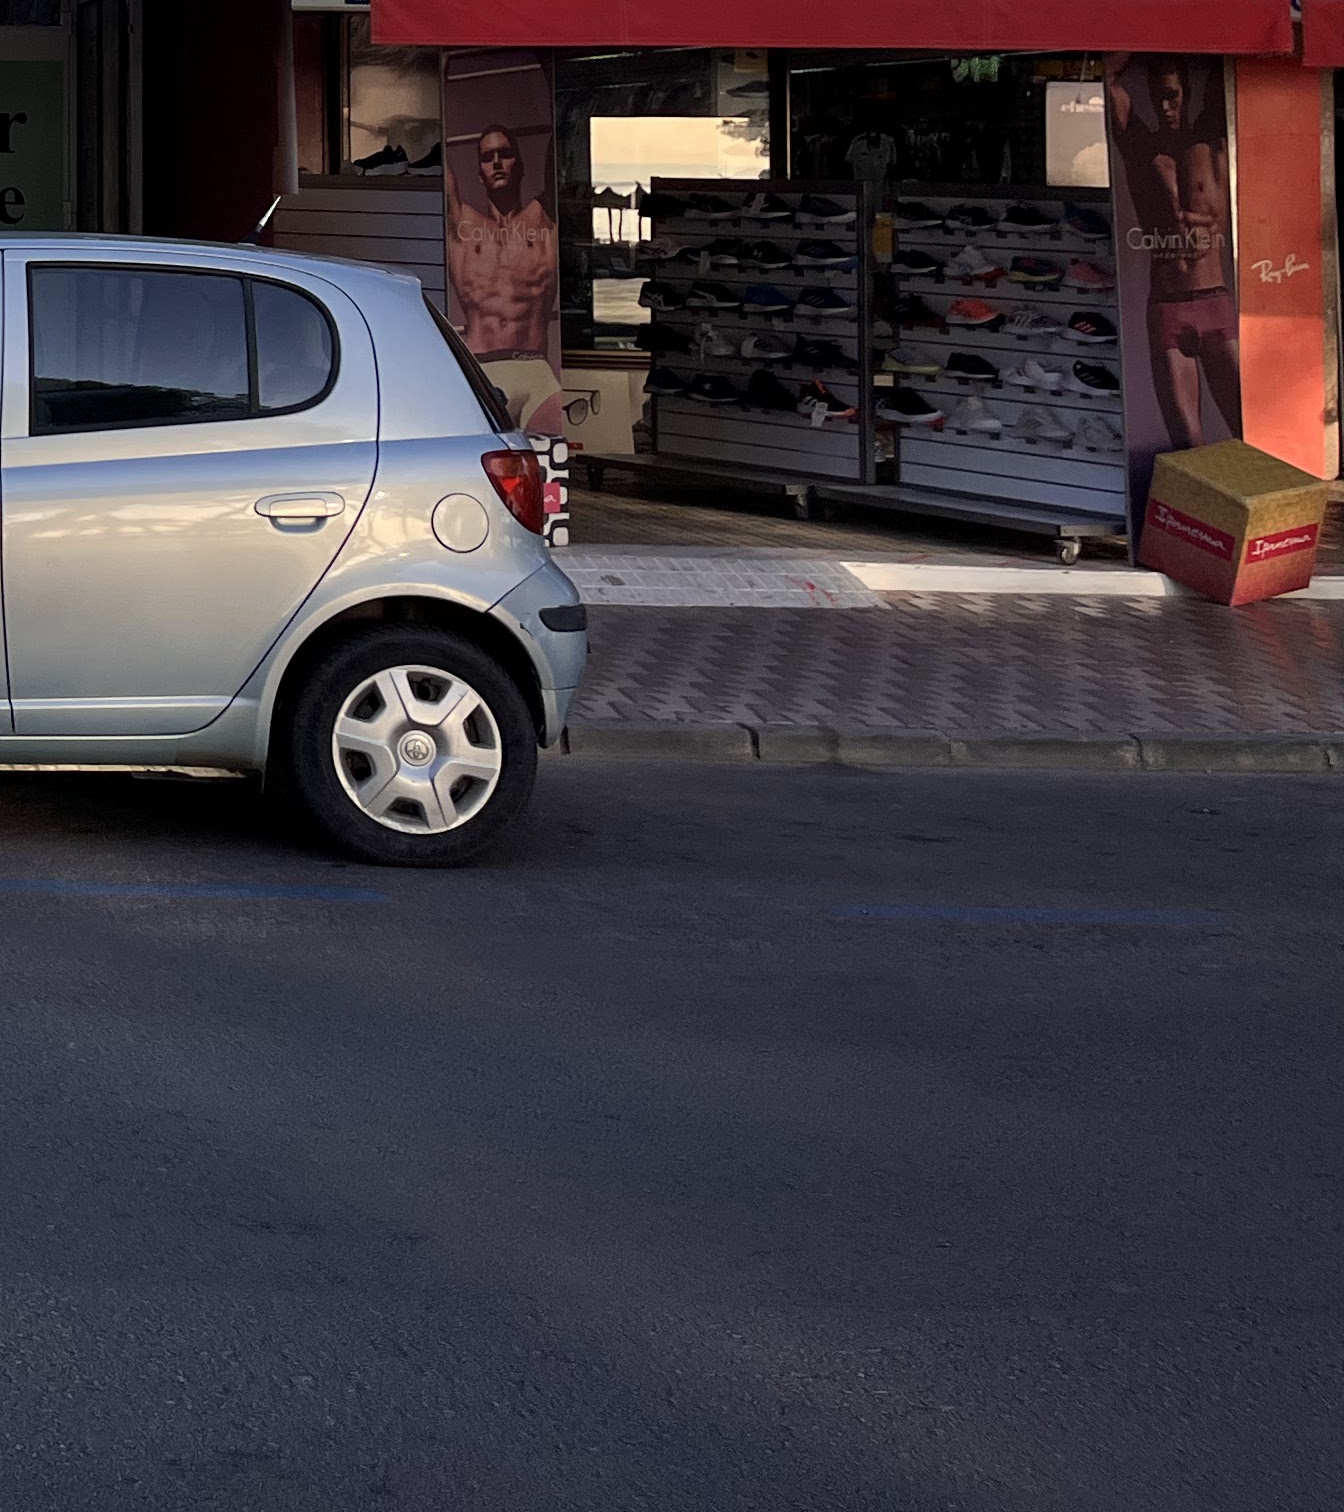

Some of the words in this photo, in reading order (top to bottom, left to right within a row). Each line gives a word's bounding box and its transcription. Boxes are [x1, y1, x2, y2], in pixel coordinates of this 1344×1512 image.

[457, 220, 509, 241] Calvin
[1126, 227, 1182, 250] Calvin
[1185, 227, 1226, 249] Klein
